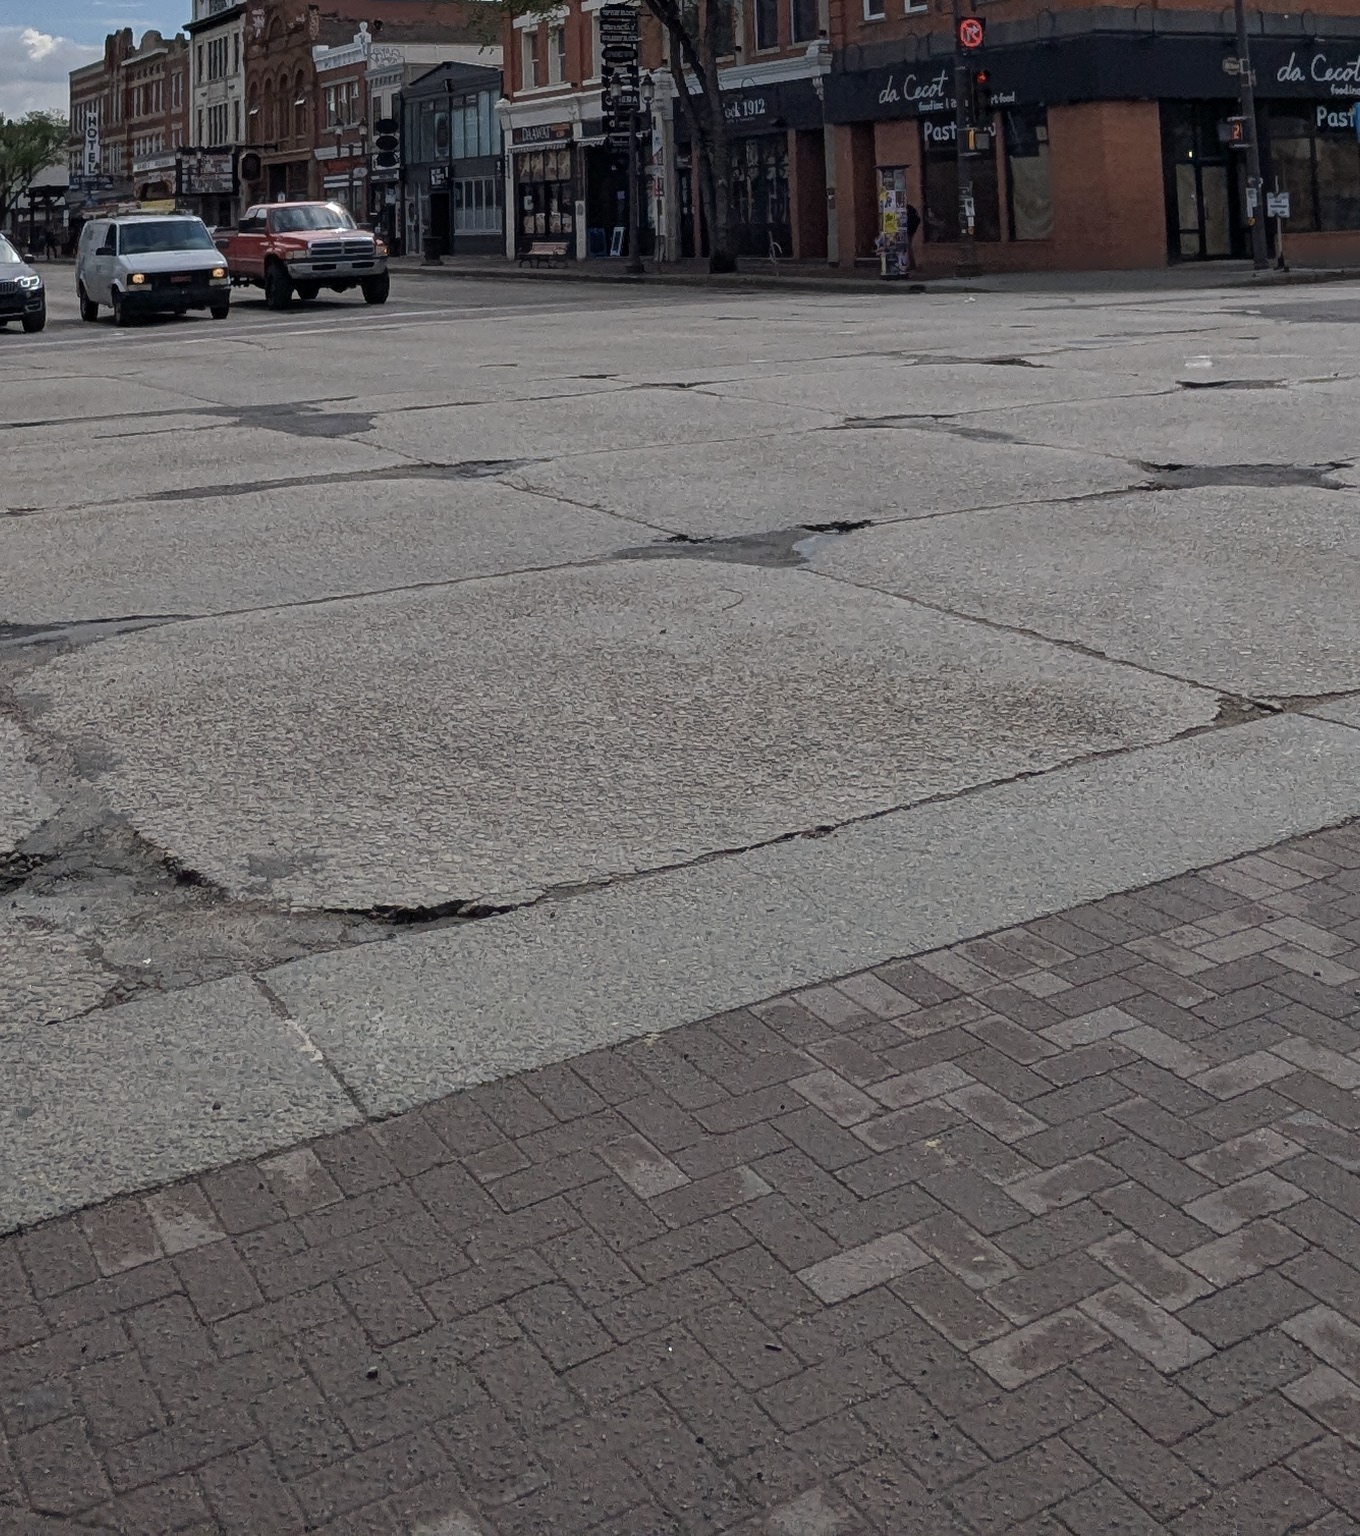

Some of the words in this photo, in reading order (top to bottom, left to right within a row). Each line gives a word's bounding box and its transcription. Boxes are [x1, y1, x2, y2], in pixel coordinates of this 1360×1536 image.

[1316, 105, 1355, 128] Past
[924, 121, 958, 141] Past
[87, 116, 98, 174] HOTEL
